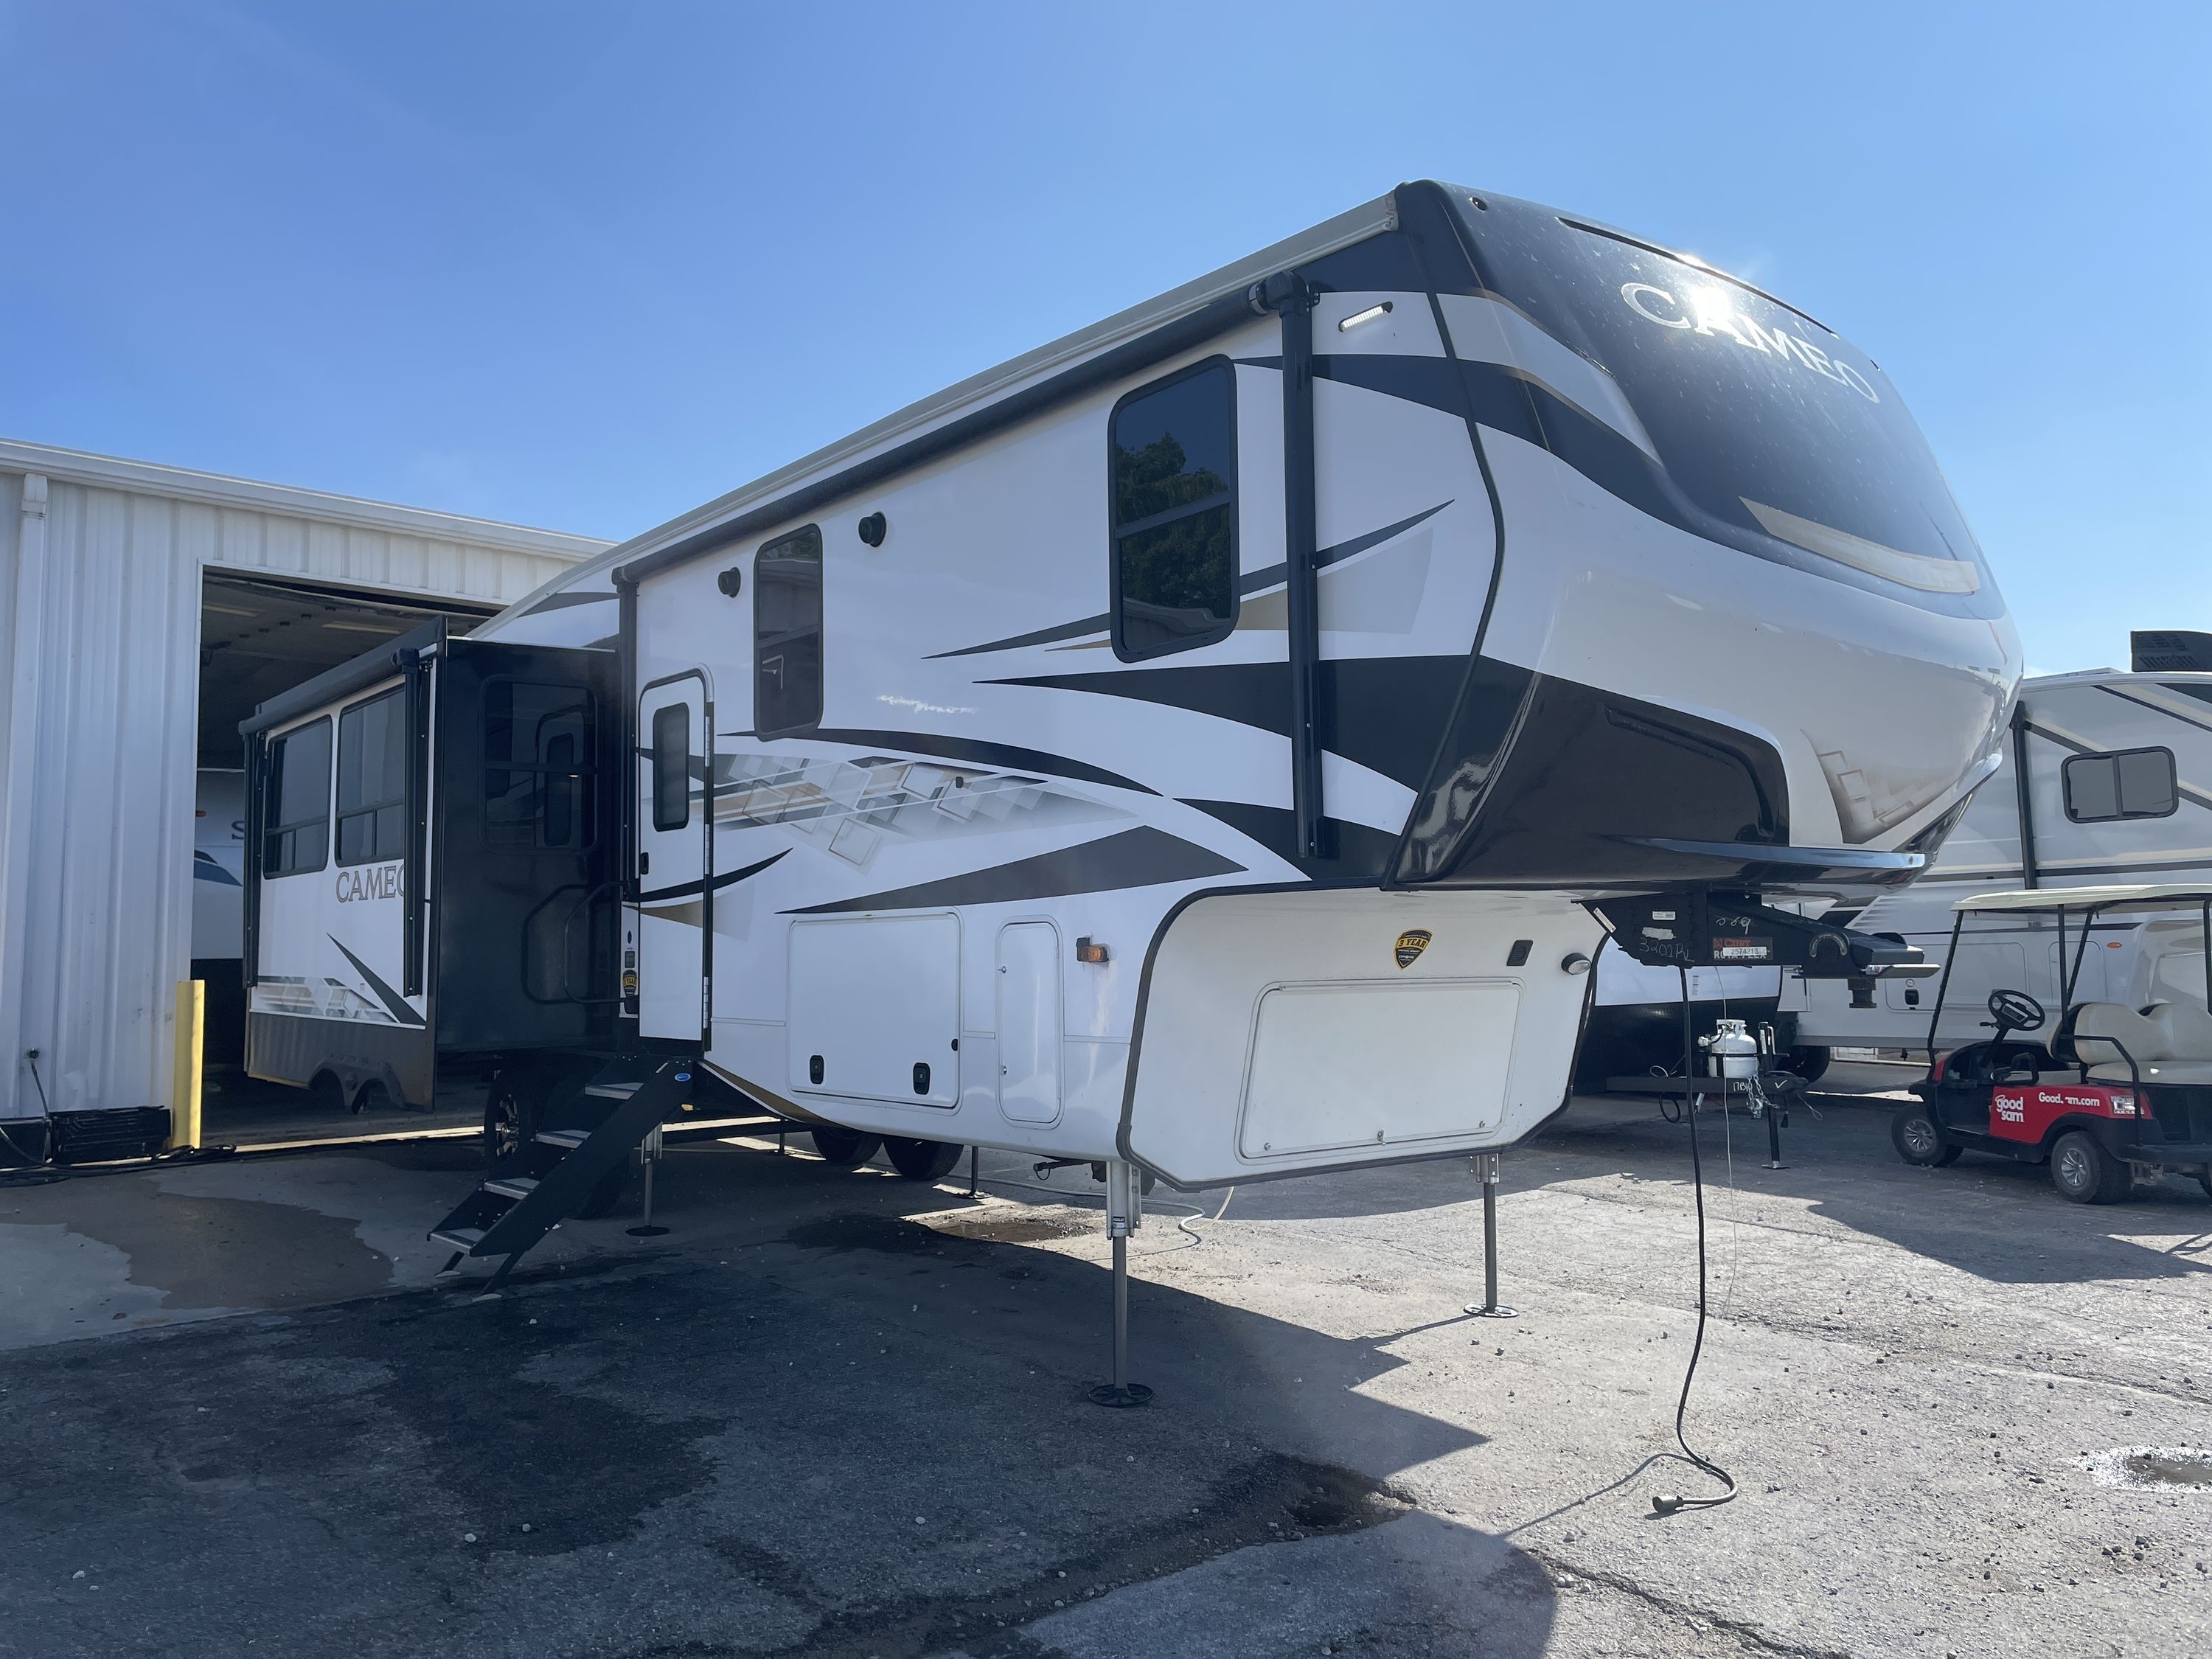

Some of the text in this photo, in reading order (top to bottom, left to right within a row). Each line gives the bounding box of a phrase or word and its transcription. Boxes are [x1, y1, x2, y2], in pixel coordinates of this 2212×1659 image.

[1621, 282, 1880, 403] CAMEO
[1406, 939, 1427, 948] YEAR
[1995, 1096, 2023, 1112] good
[2001, 1110, 2024, 1122] sam
